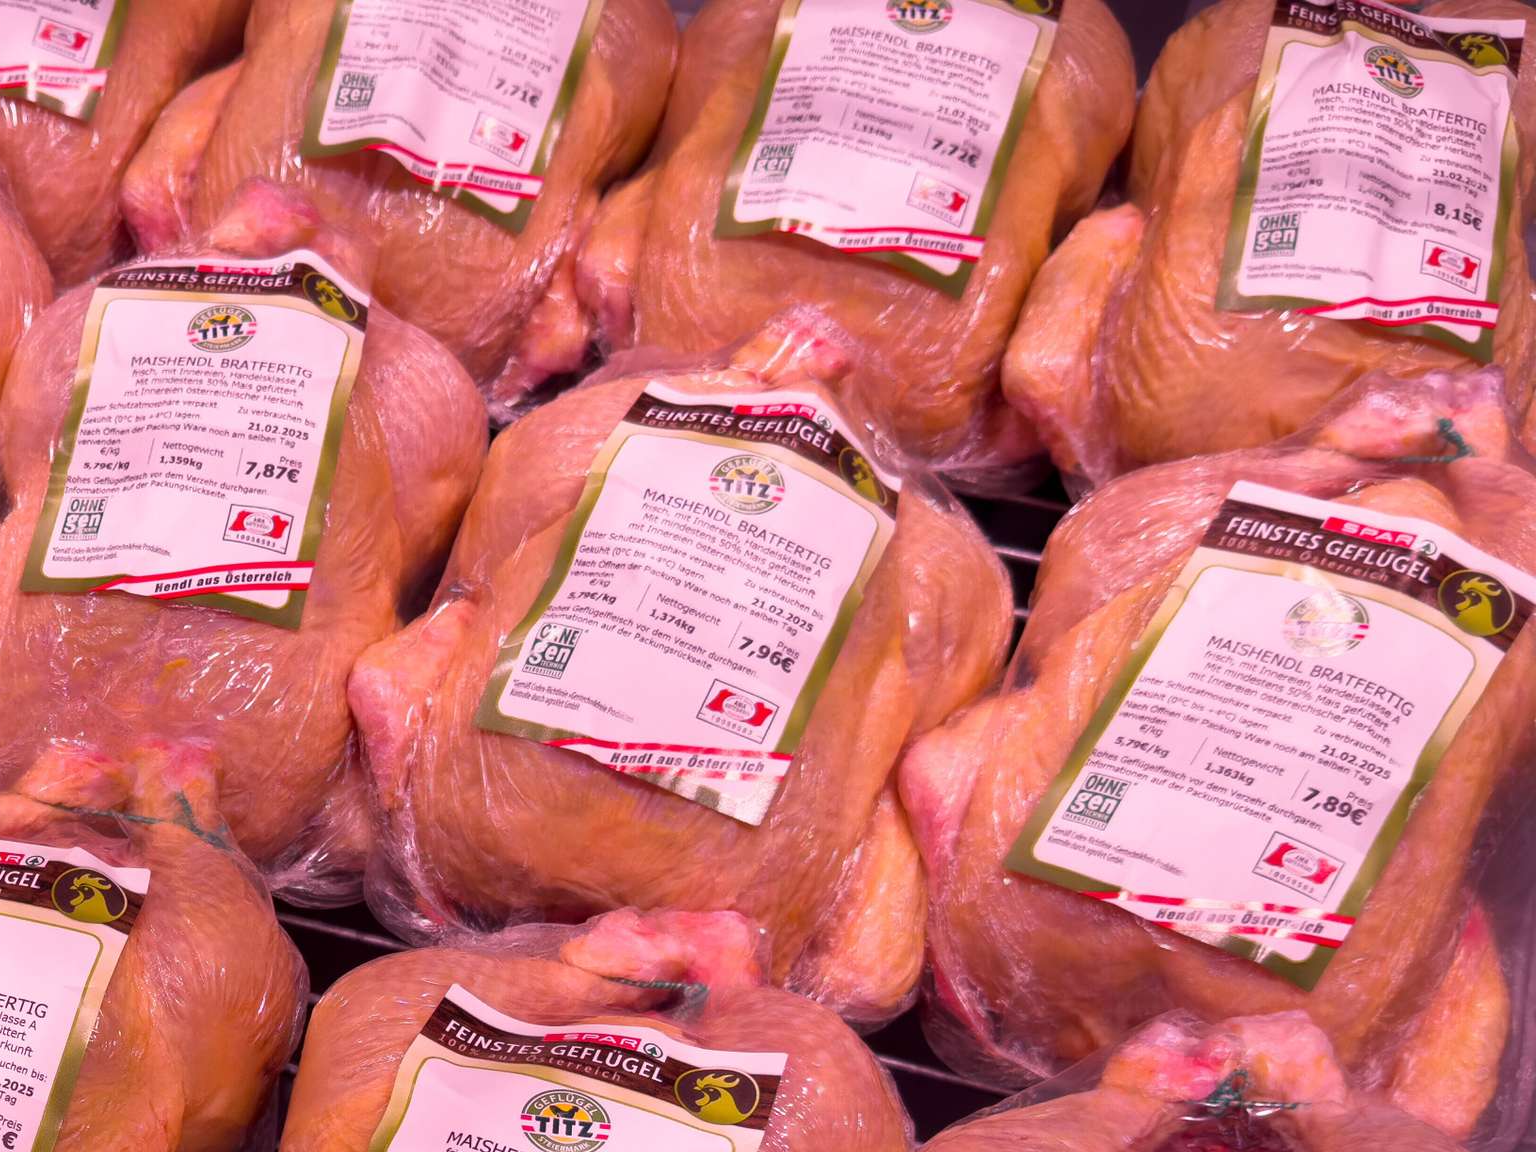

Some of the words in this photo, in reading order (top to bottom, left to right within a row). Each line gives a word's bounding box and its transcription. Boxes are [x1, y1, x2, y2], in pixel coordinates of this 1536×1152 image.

[117, 272, 199, 283] FEINSTES
[202, 272, 293, 288] GEFLÜGEL
[198, 324, 244, 339] TITZ
[131, 356, 215, 368] MAISHENDL
[219, 358, 313, 379] BRATFERTIG
[247, 422, 310, 441] 21.02.2025
[644, 407, 733, 427] FEINSTES
[738, 417, 834, 455] GEFLÜGEL
[159, 455, 203, 470] 1,359kg
[244, 461, 301, 484] 7,87€
[643, 488, 733, 527] MAISHENDL
[737, 521, 833, 571] BRATFERTIG
[1225, 517, 1320, 551] FEINSTES
[1325, 538, 1431, 585] GEFLÜGEL
[155, 579, 192, 593] Hendl
[197, 575, 220, 587] aus
[225, 570, 292, 586] Österreich
[751, 596, 814, 633] 21.02.2025
[736, 636, 794, 675] 7,96€
[1207, 636, 1305, 675] MAISHENDL
[1309, 664, 1416, 718] BRATFERTIG
[1319, 743, 1392, 780] 21.02.2025
[1299, 787, 1367, 827] 7,89€
[445, 1020, 544, 1056] FEINSTES
[550, 1042, 664, 1083] GEFLÜGEL
[538, 1117, 594, 1138] TITZ
